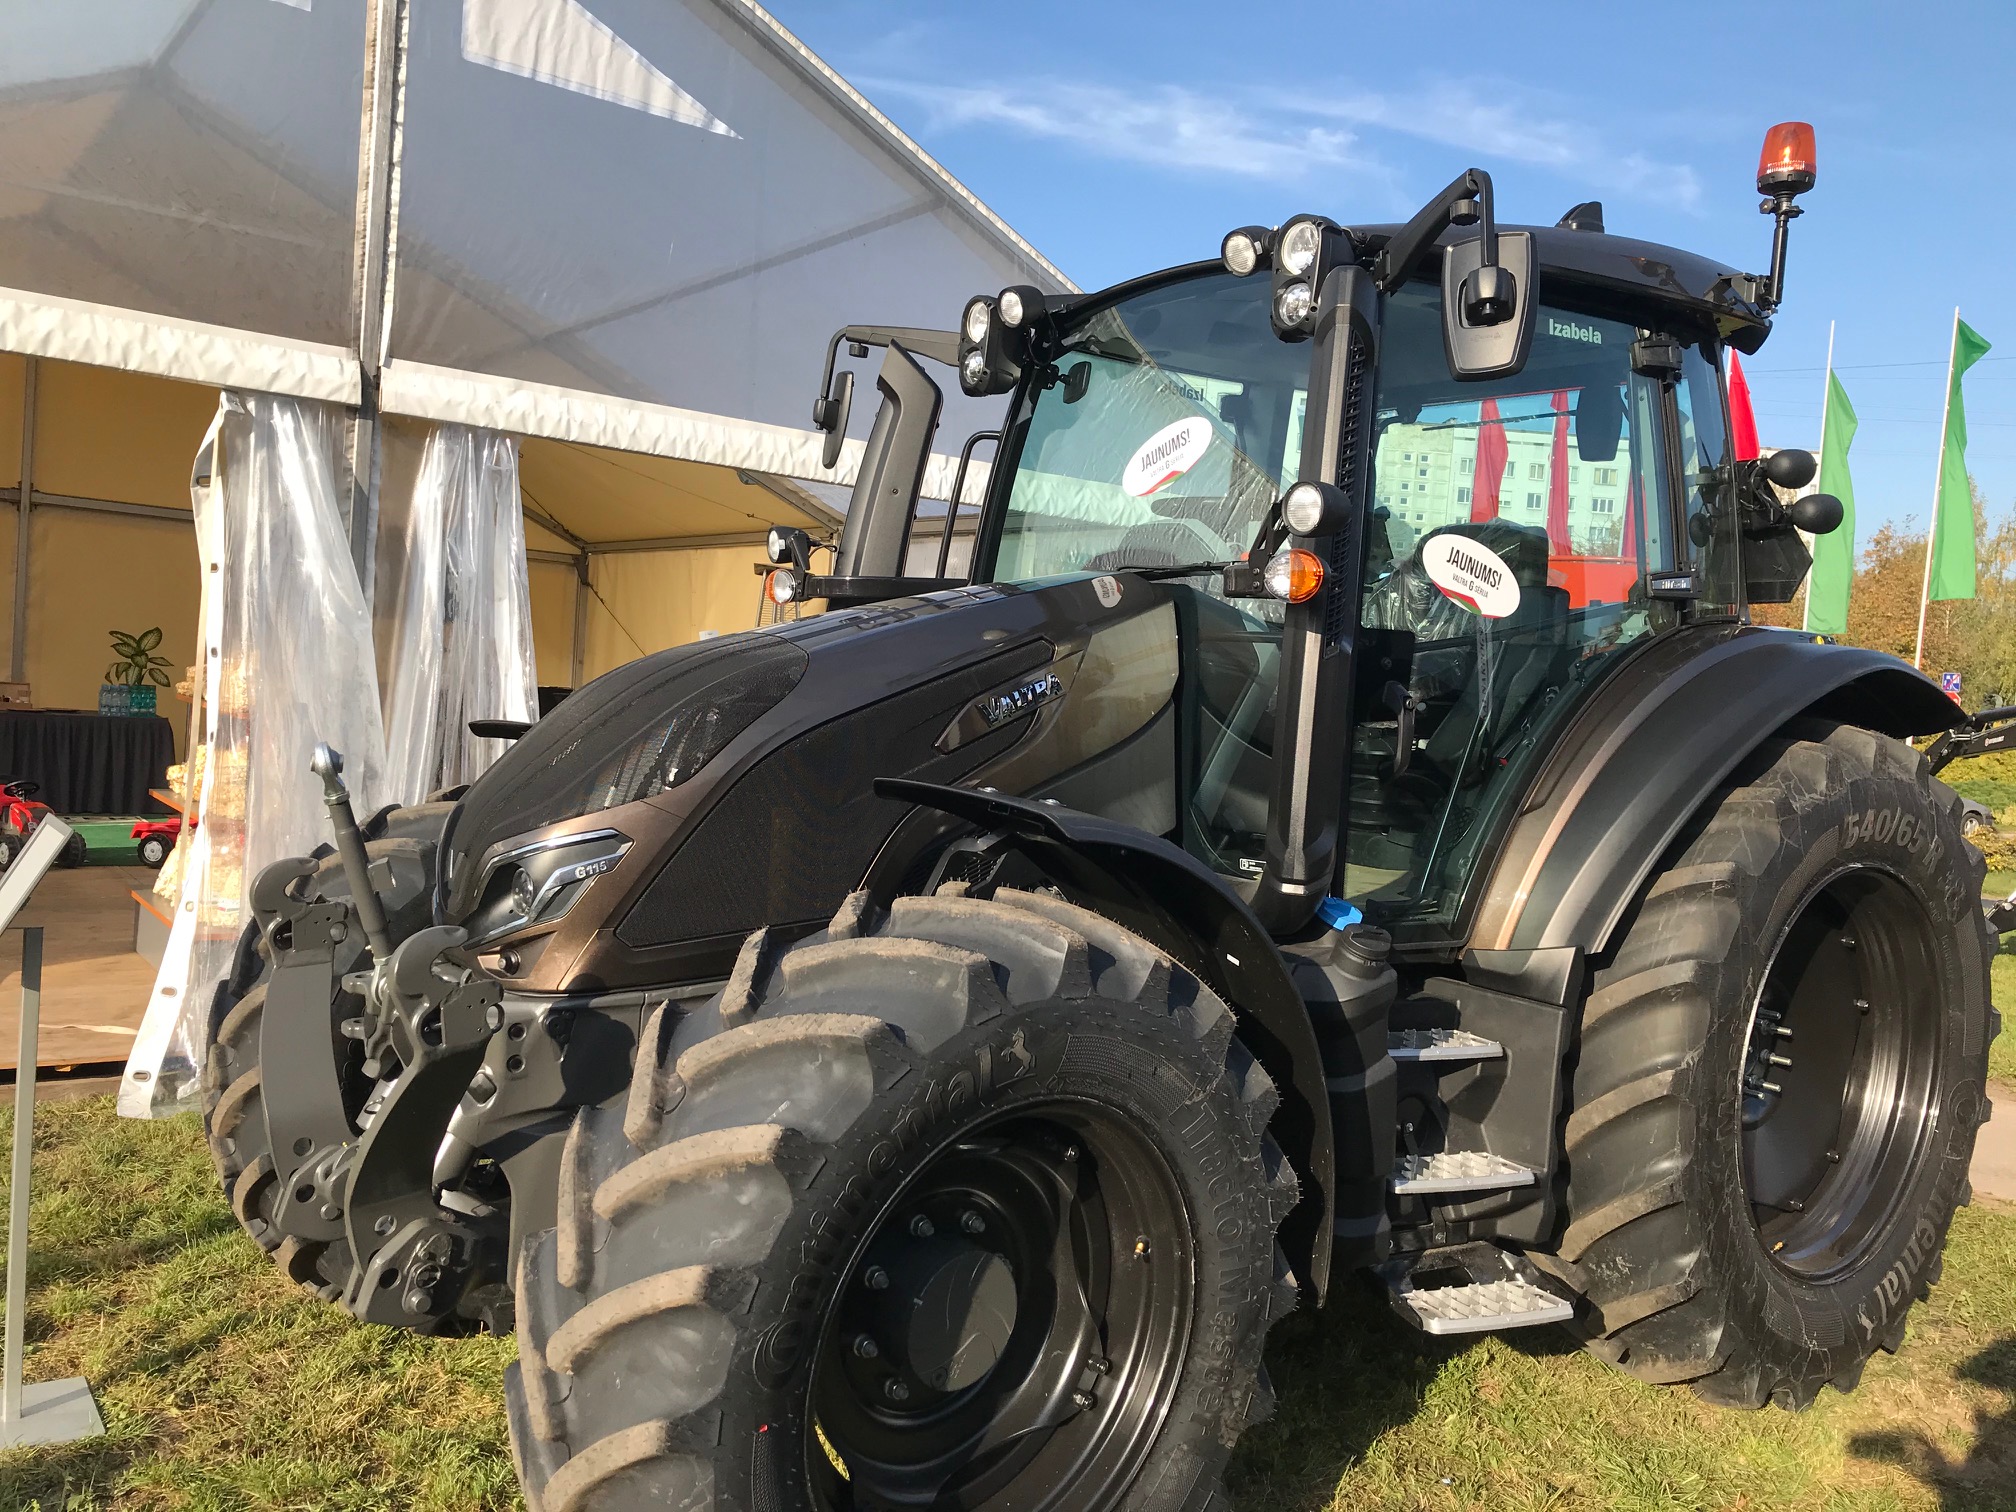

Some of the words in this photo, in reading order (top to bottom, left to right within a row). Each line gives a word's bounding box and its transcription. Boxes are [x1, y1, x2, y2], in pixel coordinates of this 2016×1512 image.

[1549, 318, 1602, 344] Izabela
[1142, 428, 1190, 472] JAUNUMS!
[1446, 547, 1502, 590] JAUNUMS!
[977, 672, 1066, 727] VALTRA
[574, 860, 607, 879] G115
